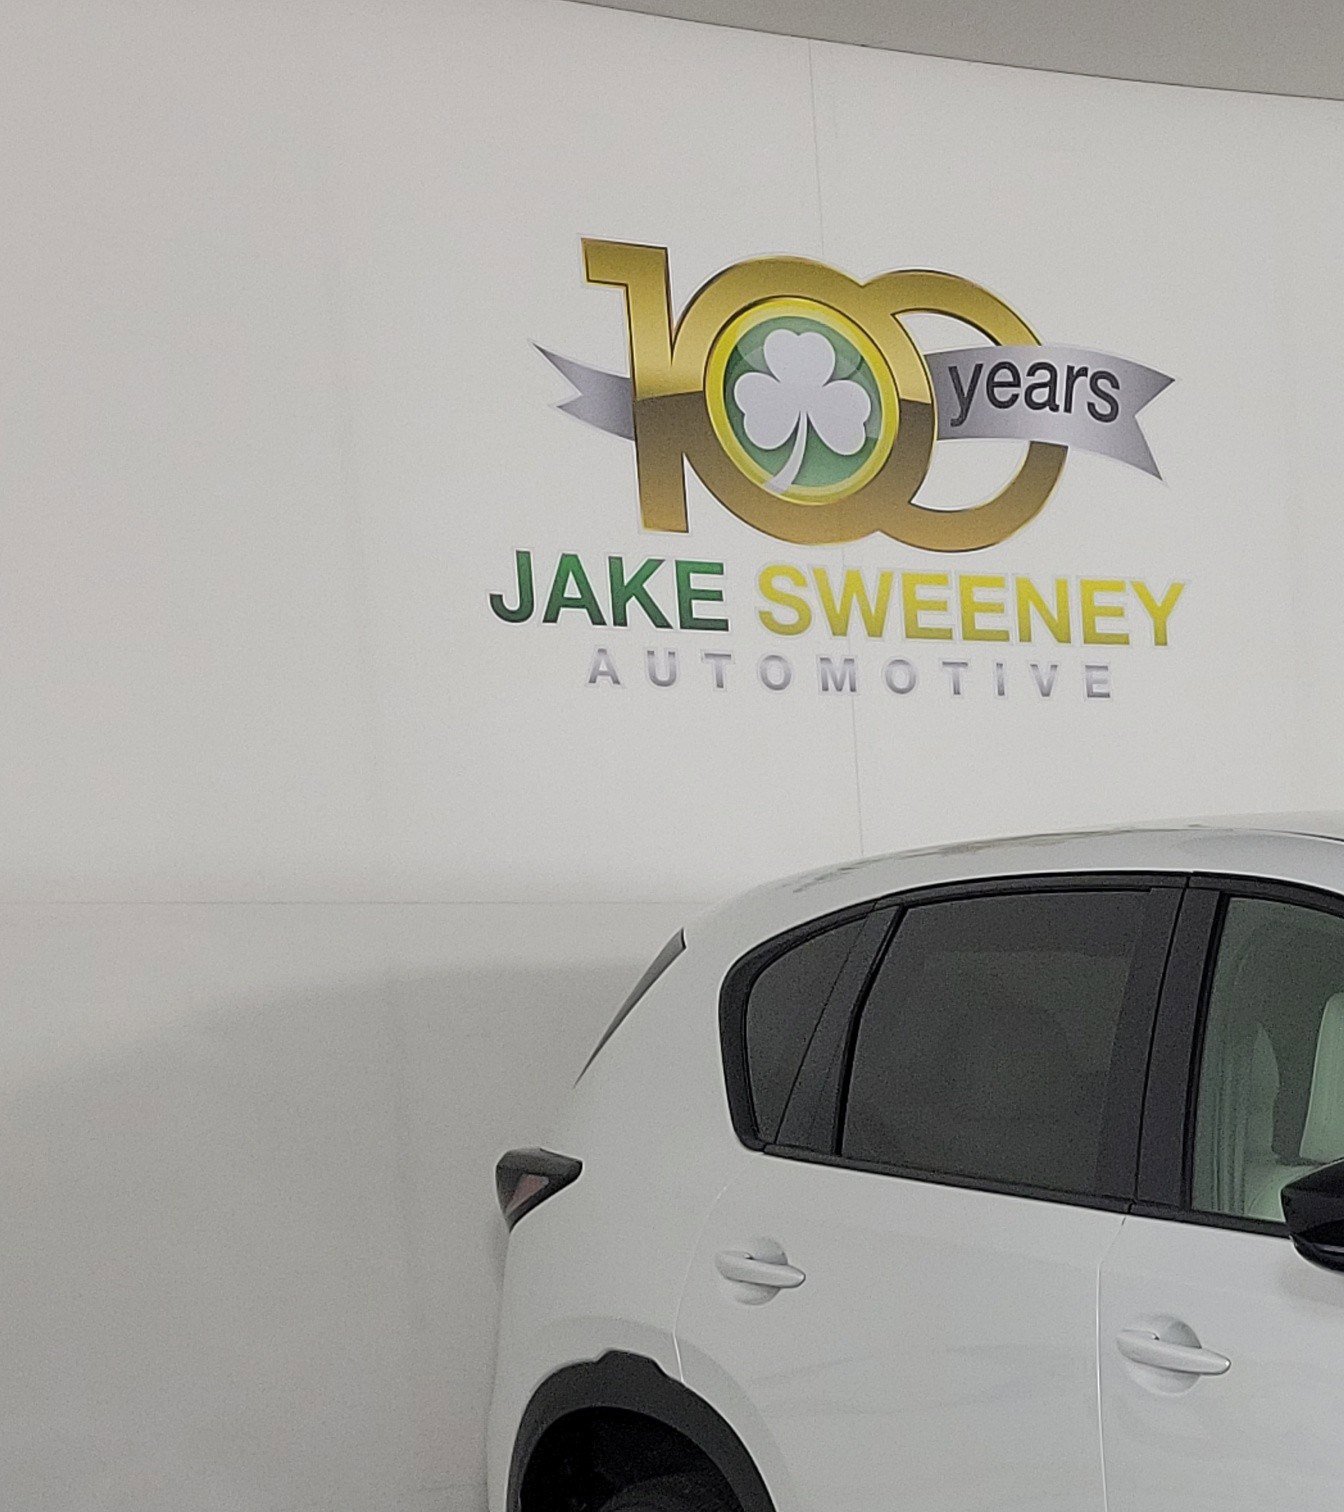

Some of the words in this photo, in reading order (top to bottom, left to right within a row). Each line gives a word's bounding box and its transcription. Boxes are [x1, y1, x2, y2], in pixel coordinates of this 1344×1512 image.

[946, 360, 1122, 427] years
[488, 550, 730, 633] JAKE
[757, 564, 1186, 647] SWEENEY
[587, 647, 1112, 700] AUTOMOTIVE
